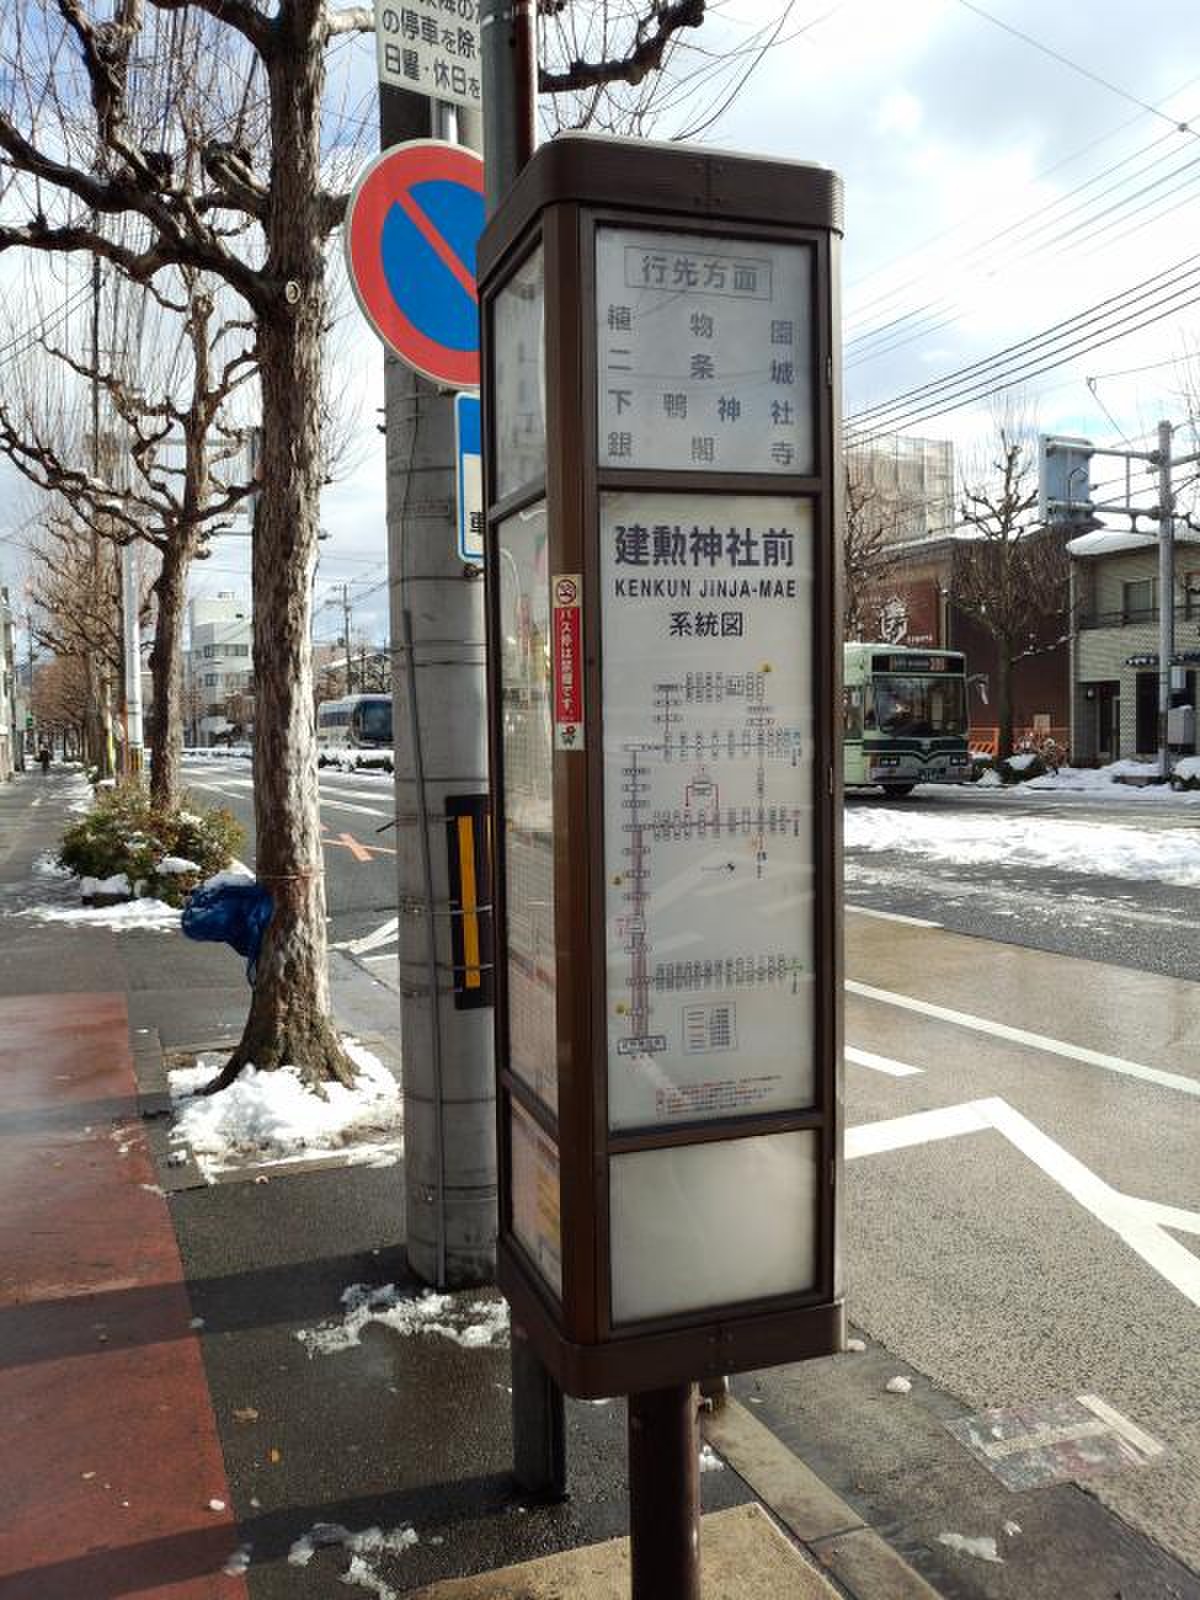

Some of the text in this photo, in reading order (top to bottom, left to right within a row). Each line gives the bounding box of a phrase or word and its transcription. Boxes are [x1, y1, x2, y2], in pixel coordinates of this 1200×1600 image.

[383, 8, 480, 60] の停車を除
[641, 255, 757, 292] 行先方面
[608, 389, 795, 425] 下鴨神社
[615, 579, 797, 598] KENKUN JINJA-MAE
[669, 611, 743, 637] 系統図
